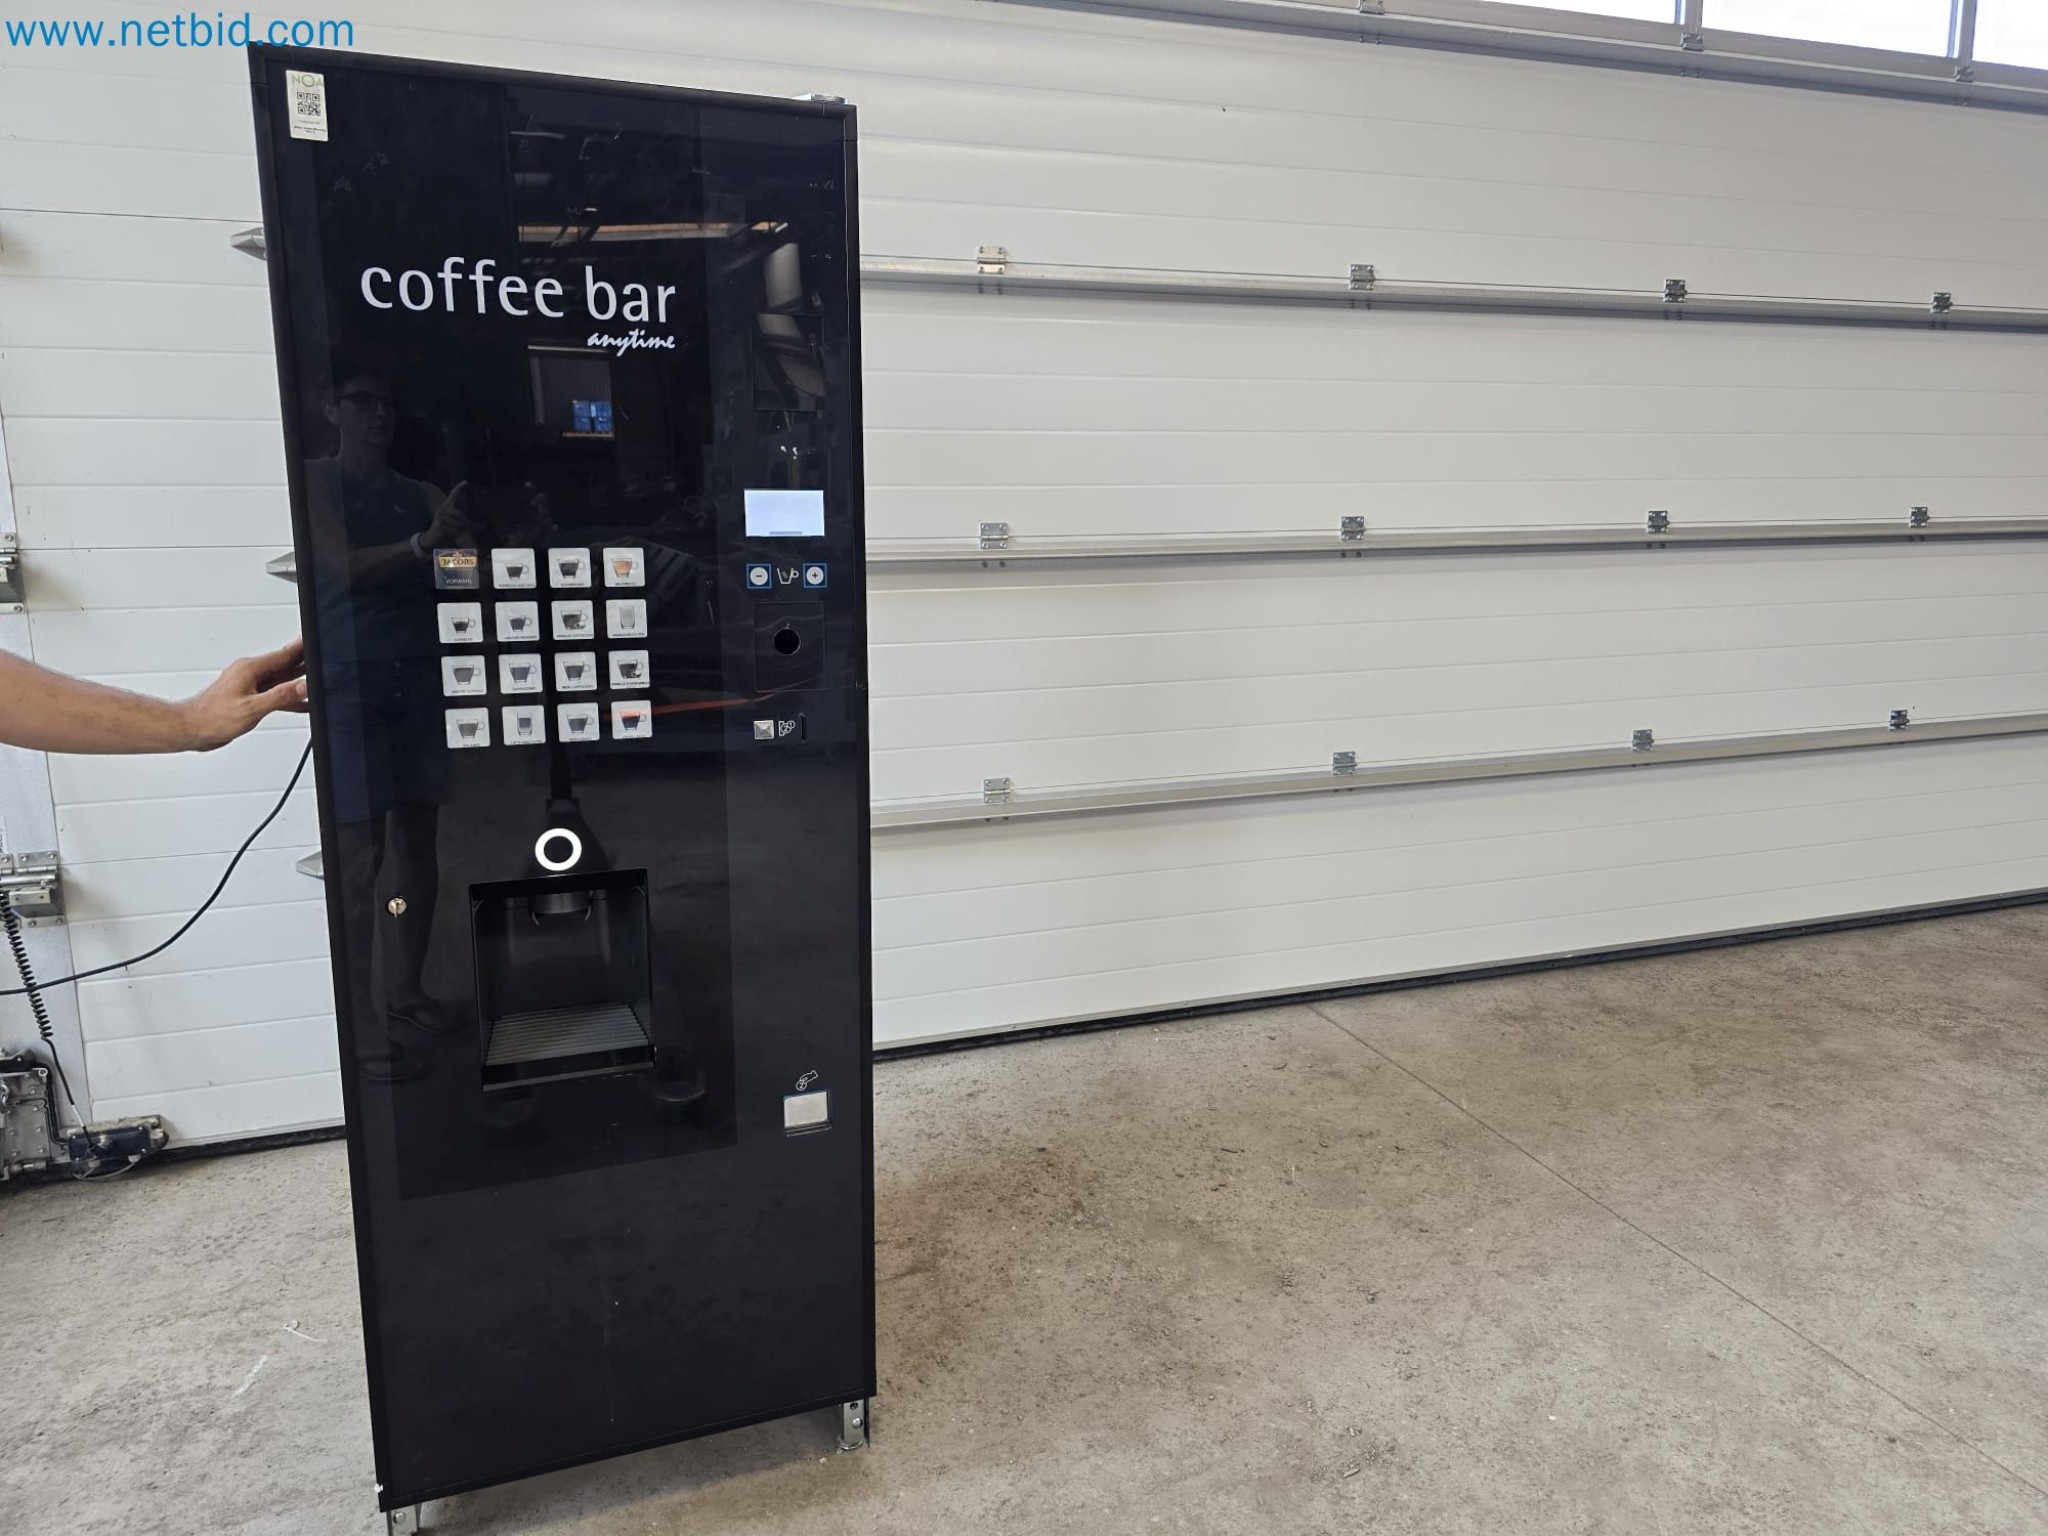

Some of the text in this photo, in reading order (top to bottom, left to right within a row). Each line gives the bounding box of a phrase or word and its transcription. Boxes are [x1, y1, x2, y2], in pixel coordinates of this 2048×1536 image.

[361, 256, 676, 323] coffee bar
[587, 328, 675, 357] anytime
